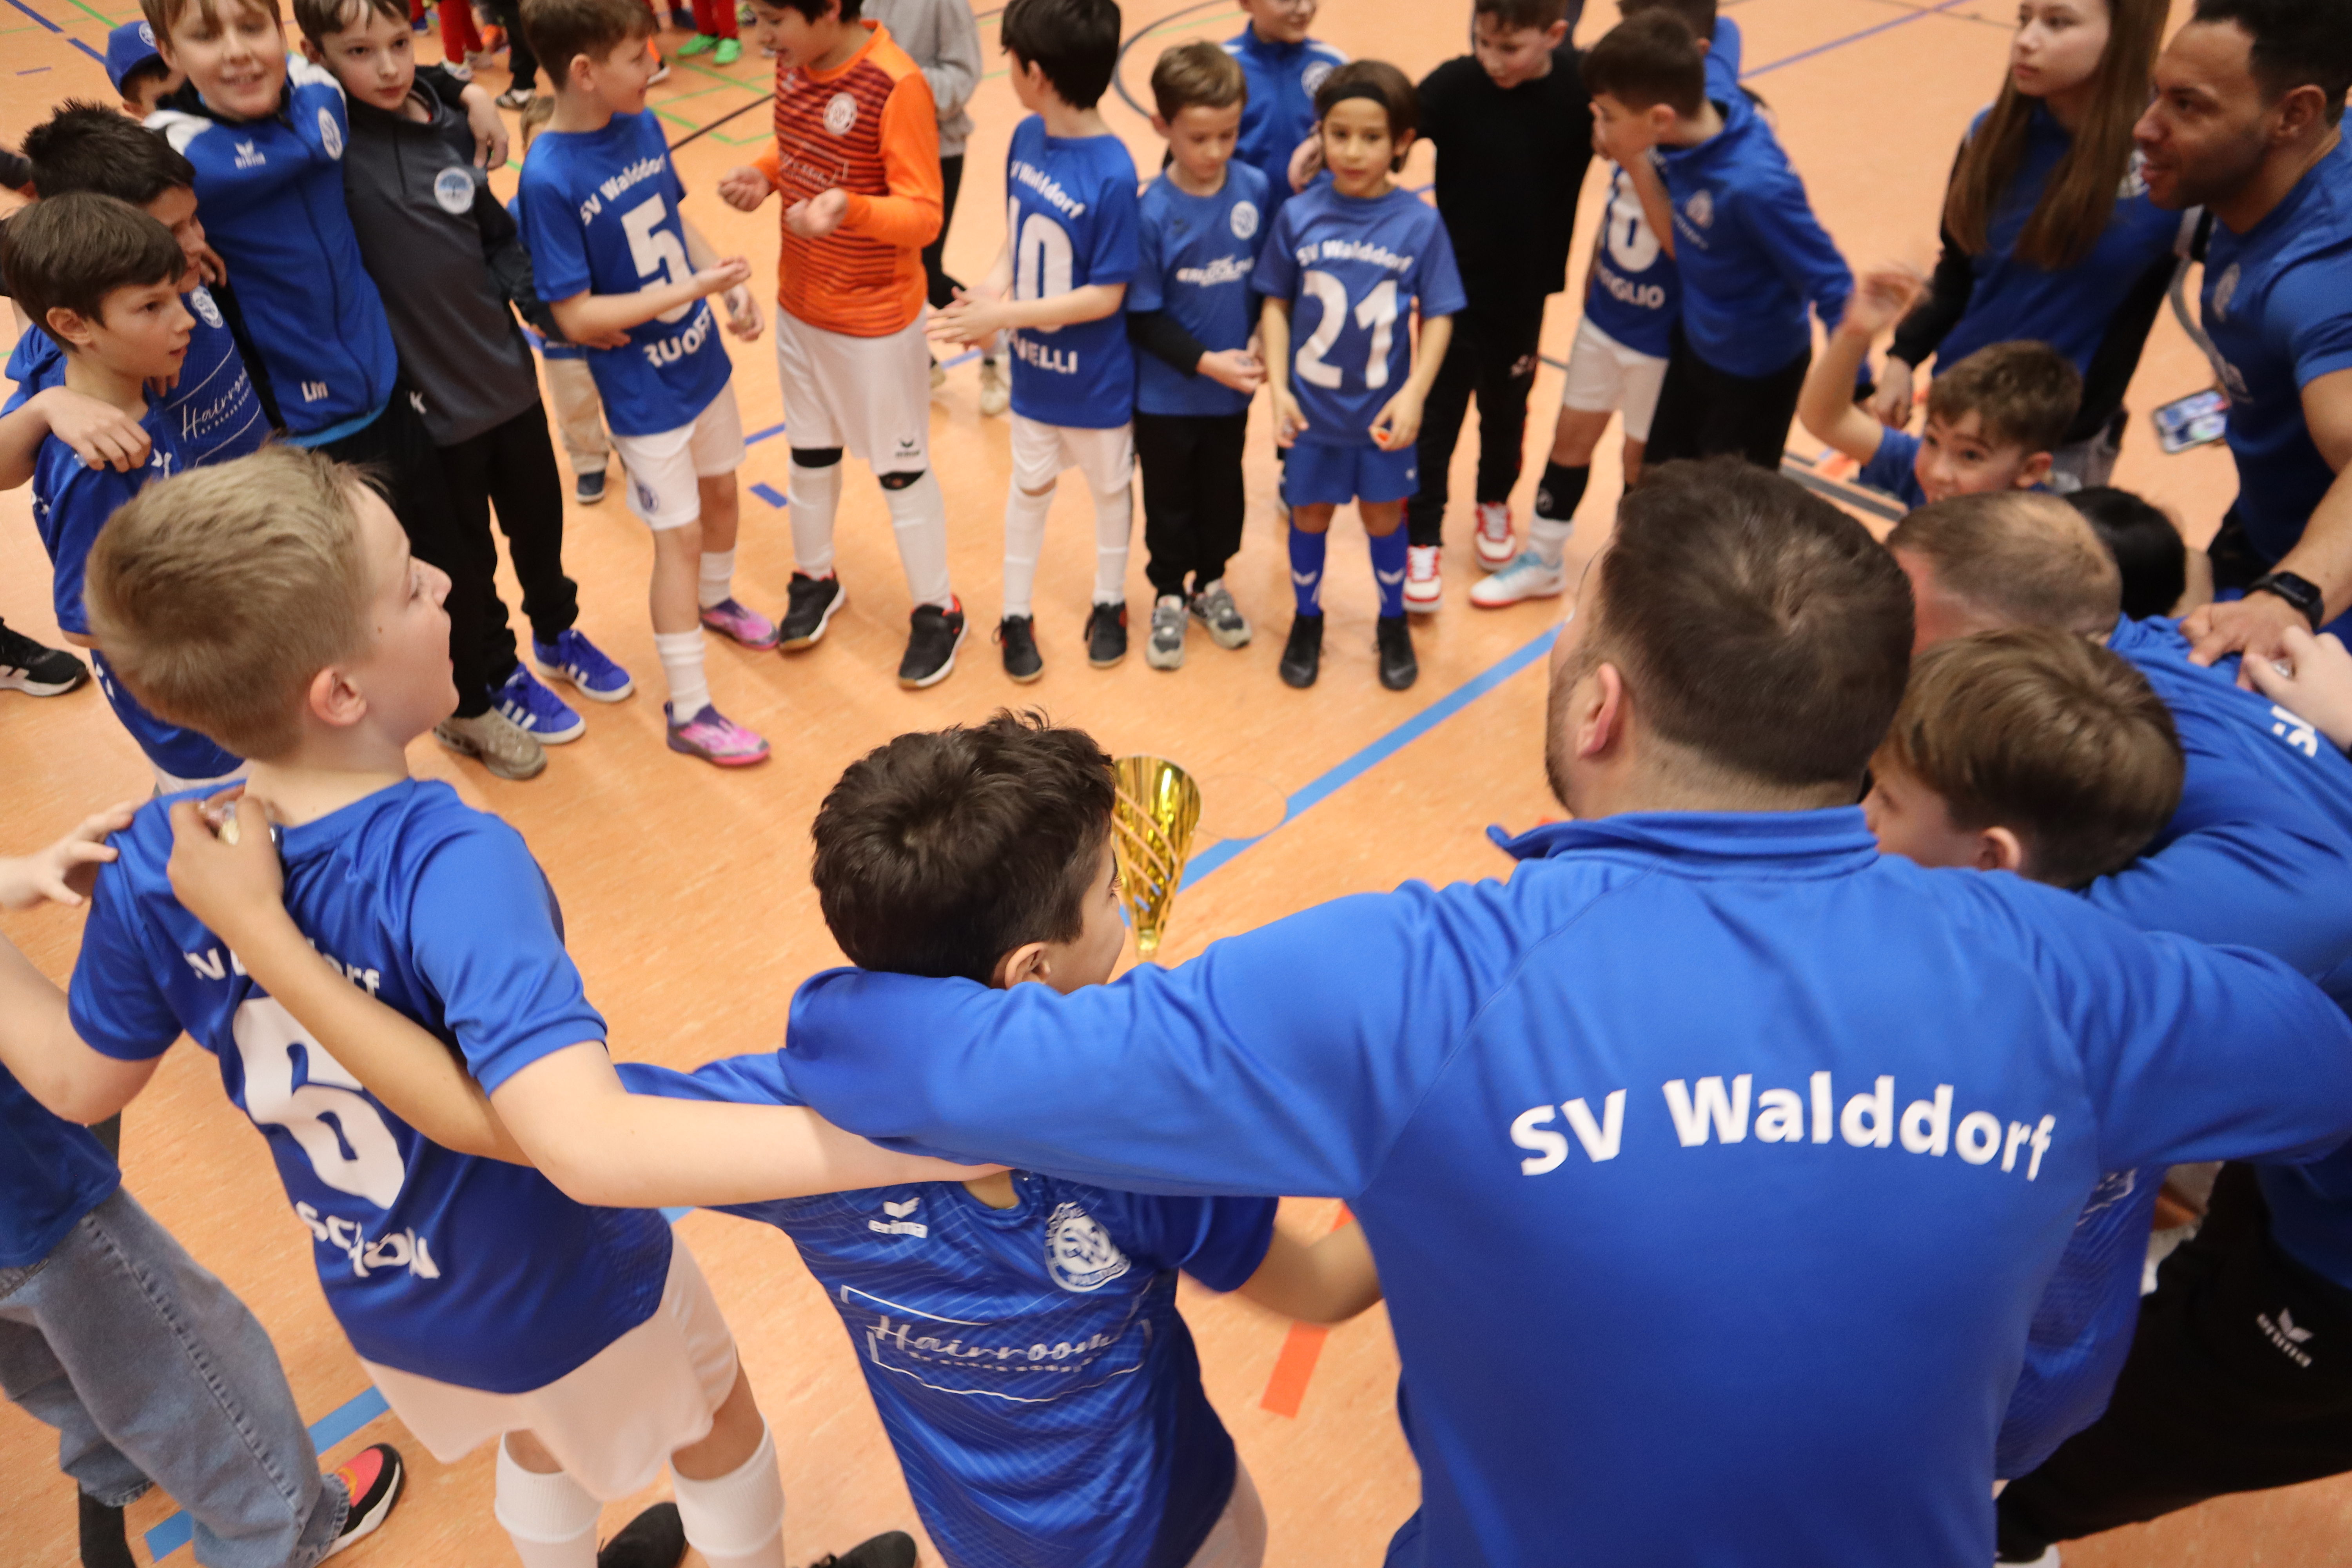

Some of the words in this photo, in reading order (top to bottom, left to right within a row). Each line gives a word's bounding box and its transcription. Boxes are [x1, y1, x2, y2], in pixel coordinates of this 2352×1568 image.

[580, 192, 602, 227] SV
[599, 153, 665, 202] Walddorf
[621, 193, 694, 325] 5
[1296, 243, 1319, 267] SV
[1322, 240, 1413, 273] Walddorf
[1295, 269, 1398, 389] 21
[233, 996, 405, 1210] 6
[1509, 1089, 1627, 1176] SV
[1661, 1070, 2057, 1181] Walddorf
[868, 1219, 928, 1238] erima
